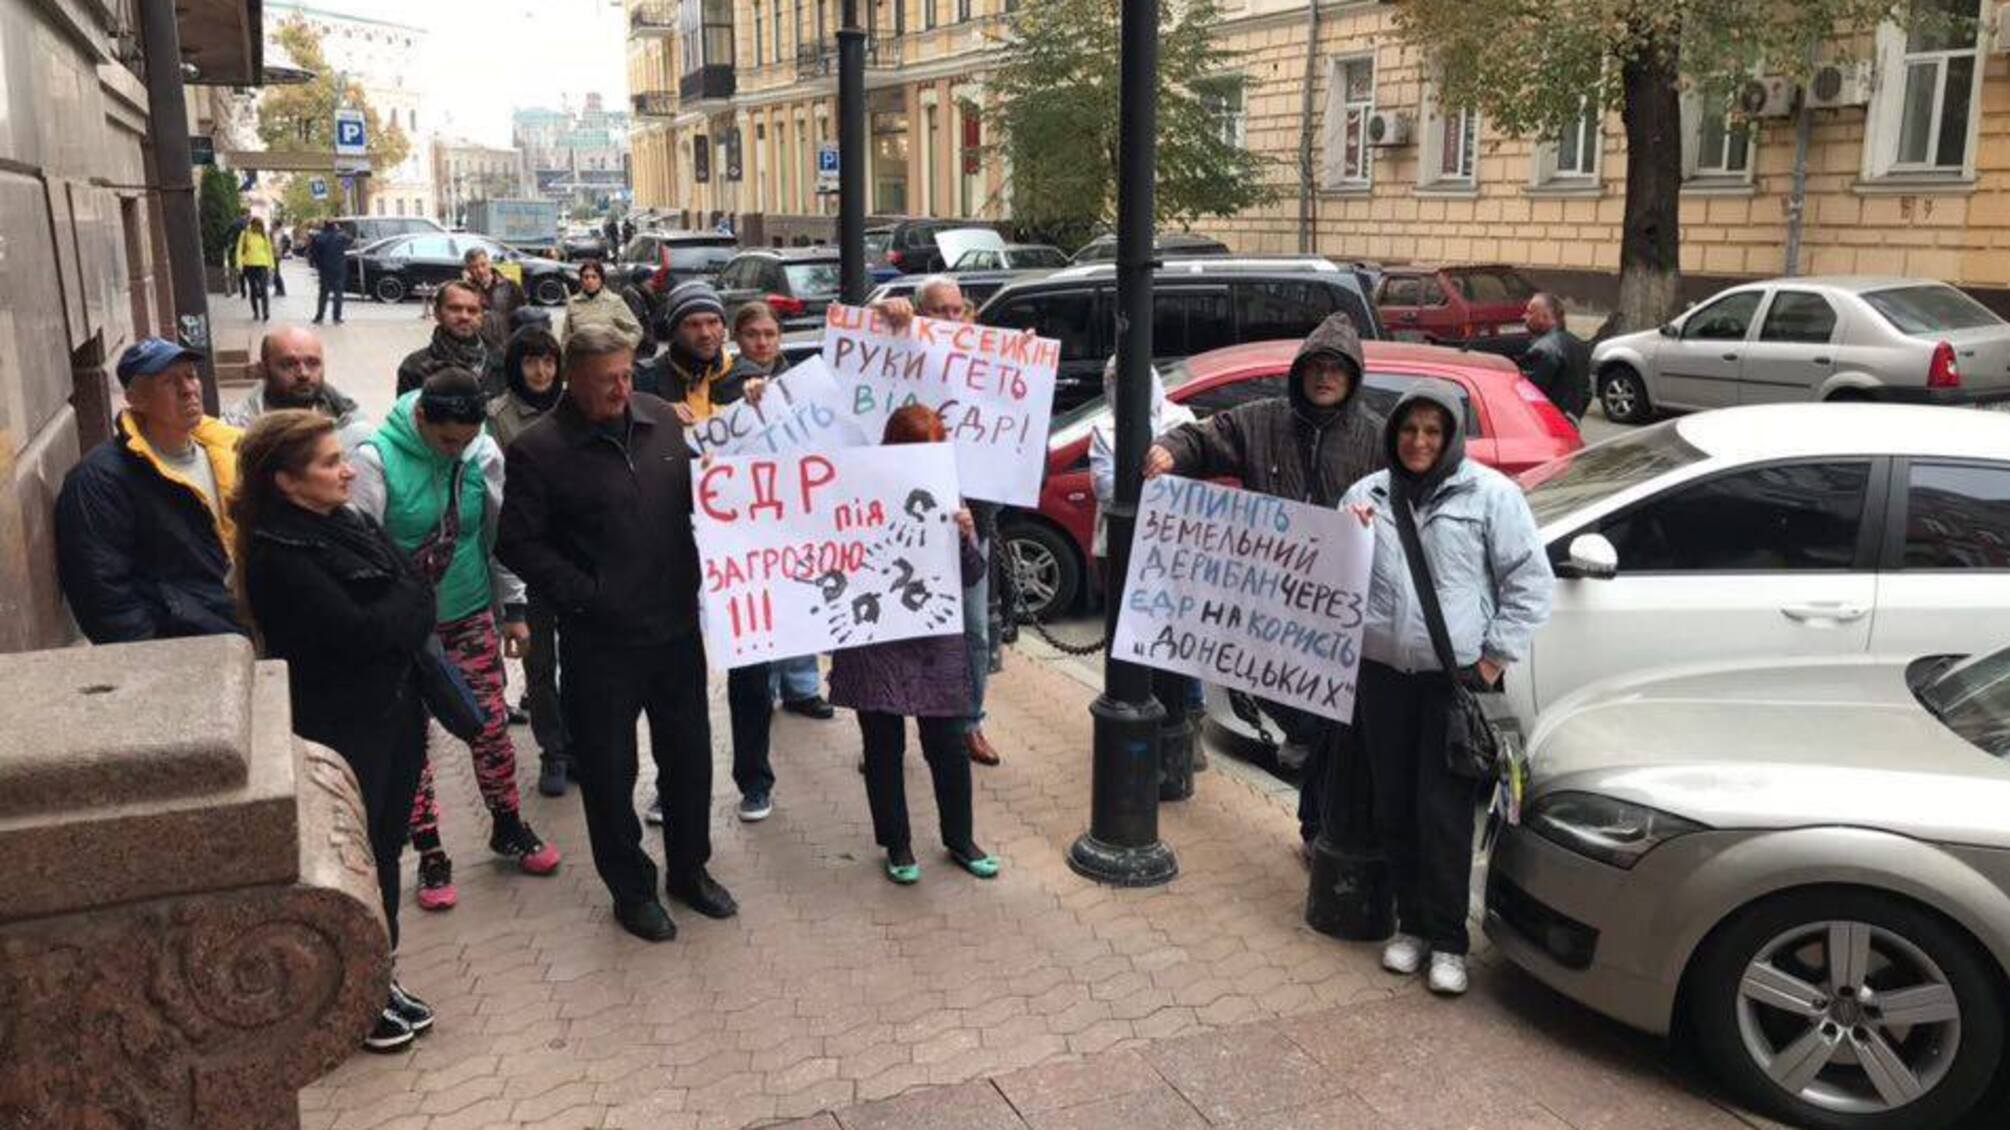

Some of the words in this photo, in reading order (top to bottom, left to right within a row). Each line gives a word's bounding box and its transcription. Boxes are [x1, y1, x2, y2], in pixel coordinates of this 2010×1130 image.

[342, 123, 360, 142] P
[834, 337, 927, 379] РУКИ
[941, 353, 1029, 400] ГЕТЬ
[699, 455, 836, 522] ЄДР
[706, 540, 865, 592] ЗАГРОЗОЮ
[1142, 511, 1320, 575] ЗЕМЕЛЬНИЙ
[1139, 546, 1278, 599] ДЕРИБАН
[1280, 576, 1364, 629] ЧЕРЕЗ
[727, 588, 773, 654] !!!
[1200, 600, 1241, 627] НА
[1248, 609, 1357, 668] КОРИСТЬ
